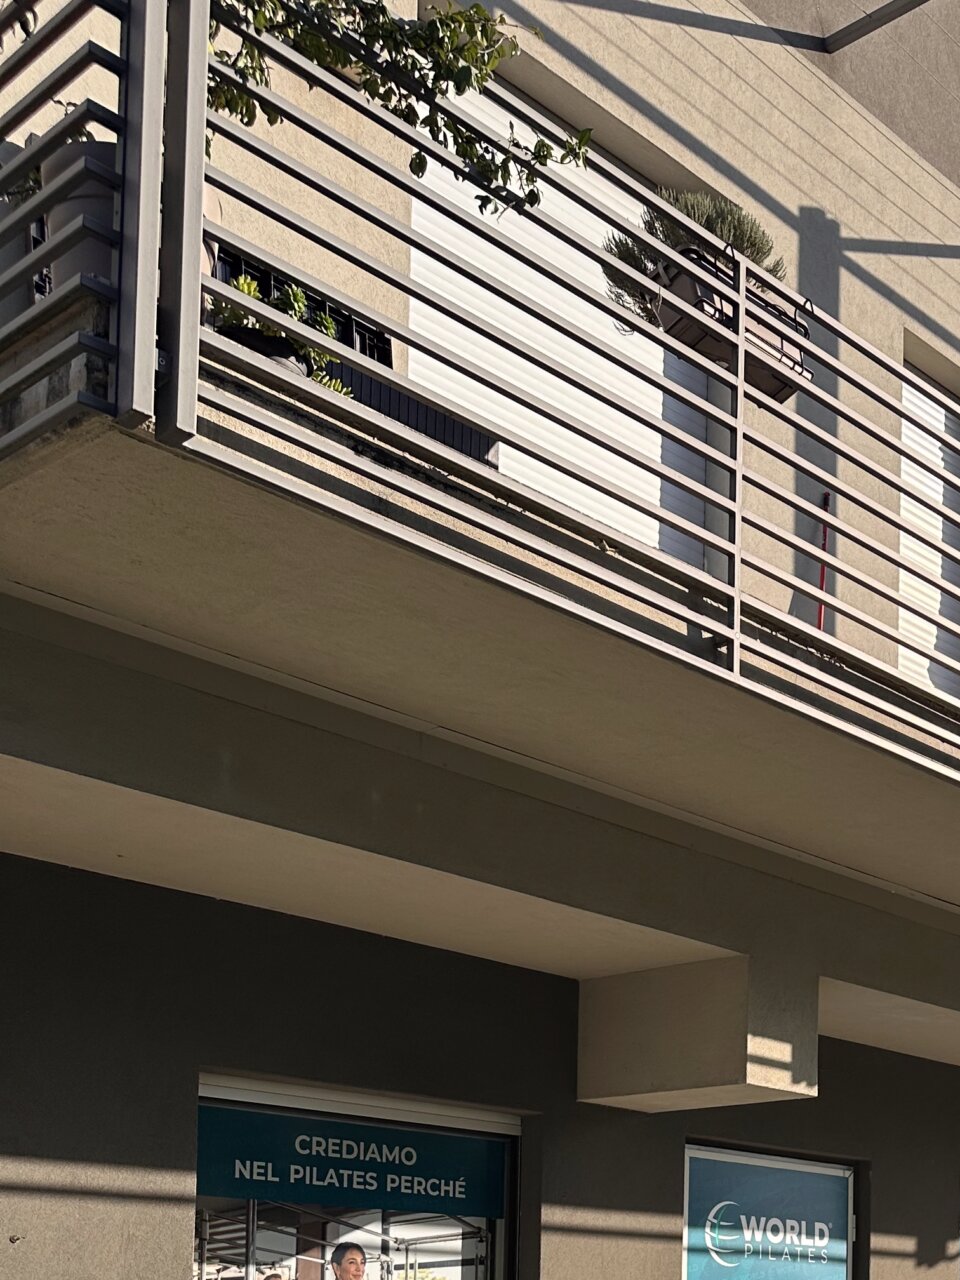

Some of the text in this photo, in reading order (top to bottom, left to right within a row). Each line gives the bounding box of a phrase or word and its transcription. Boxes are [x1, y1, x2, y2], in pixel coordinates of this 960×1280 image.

[294, 1134, 417, 1166] CREDIAMO
[234, 1159, 466, 1199] NEL PILATES PERCHÉ
[740, 1214, 830, 1247] WORLD
[744, 1243, 828, 1264] PILATES
